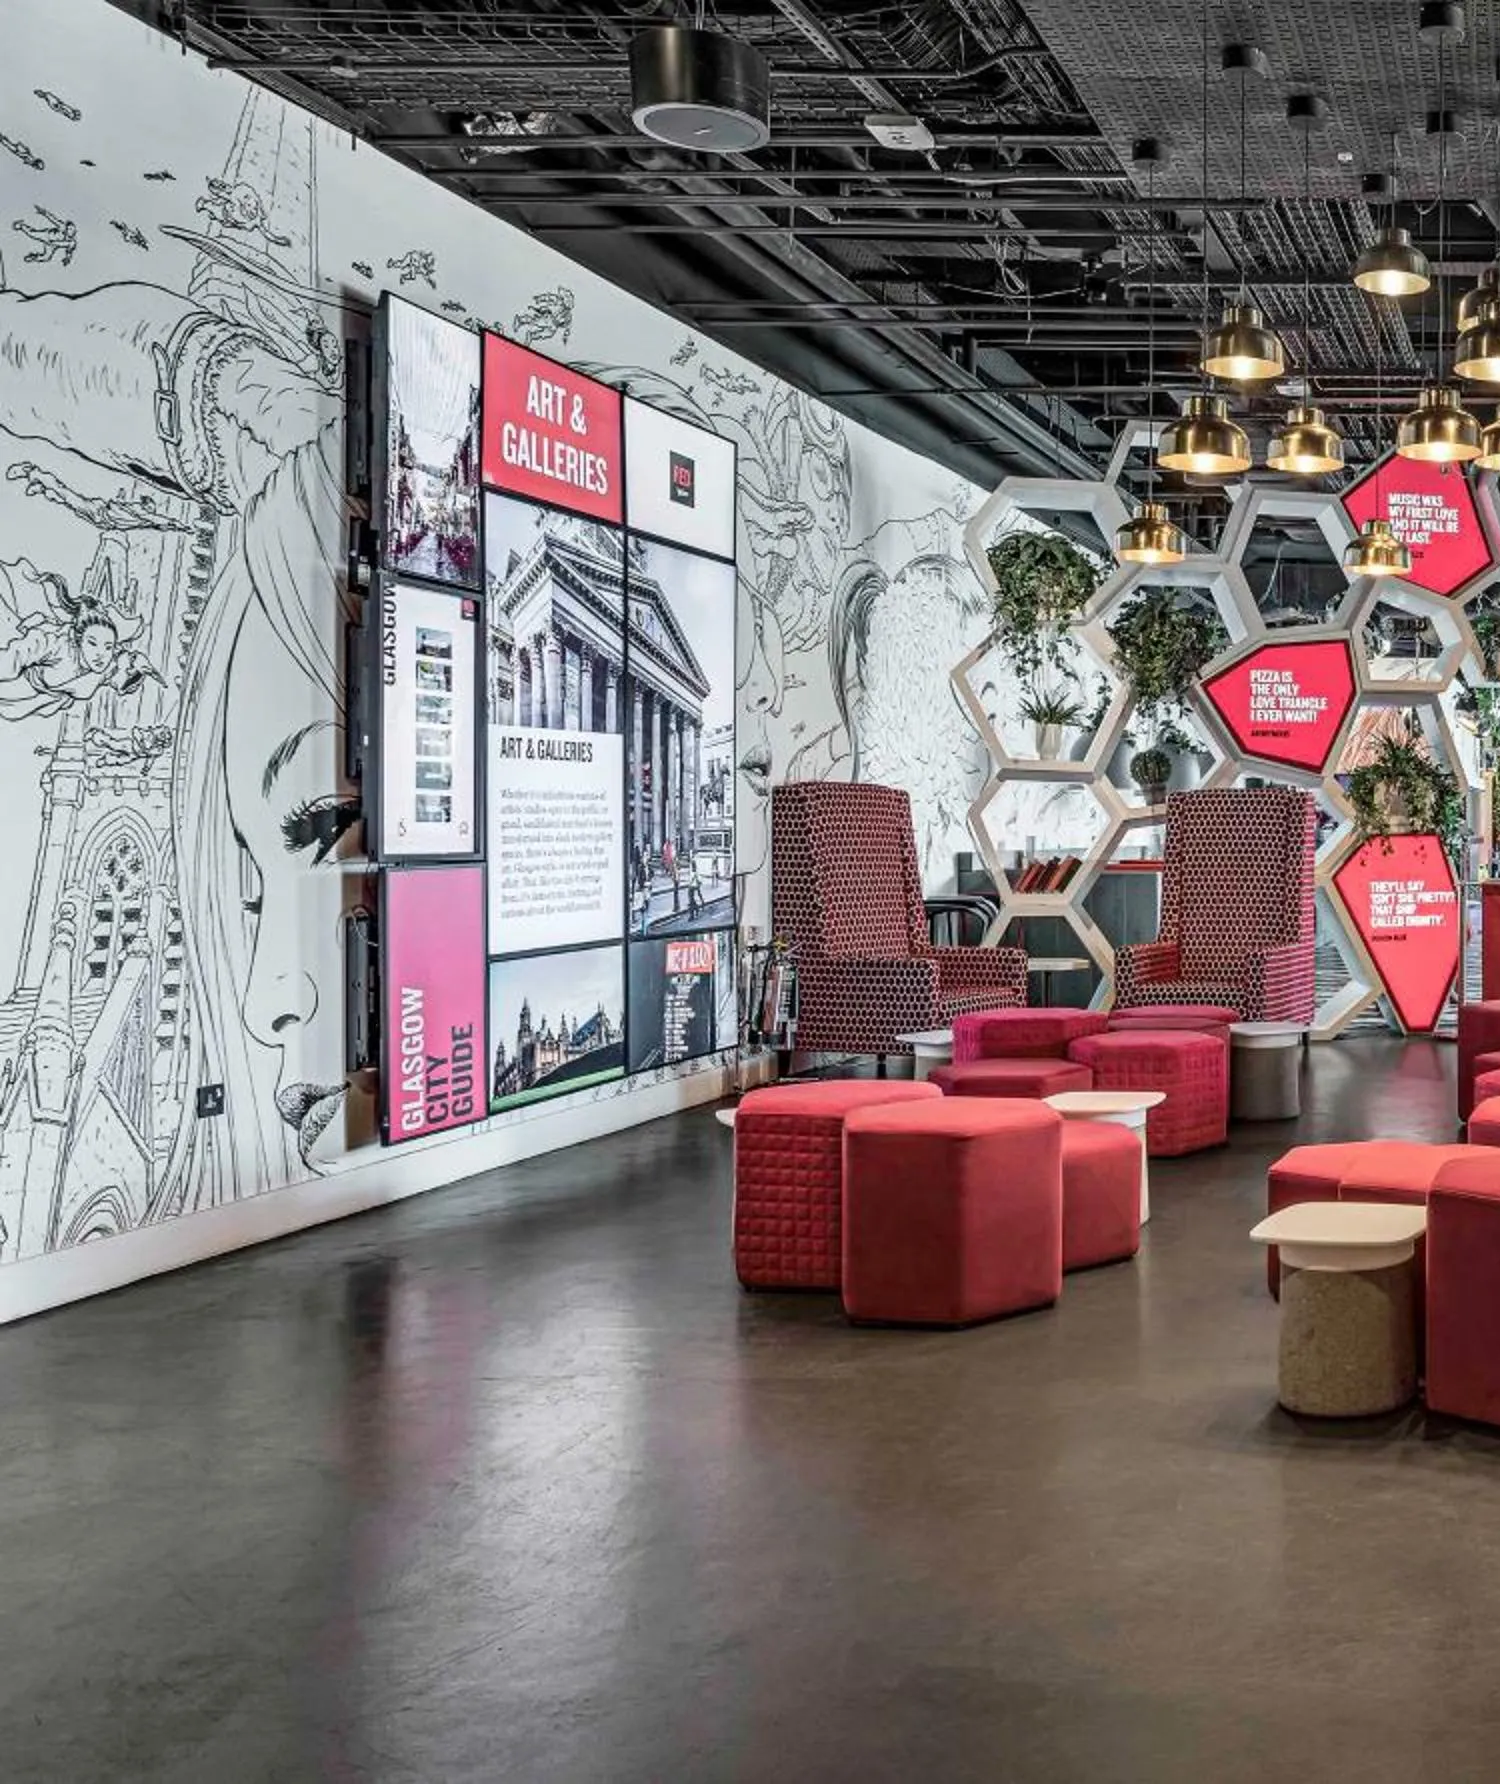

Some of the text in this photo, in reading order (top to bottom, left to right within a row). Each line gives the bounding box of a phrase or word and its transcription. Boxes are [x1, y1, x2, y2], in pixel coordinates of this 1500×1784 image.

[526, 375, 588, 437] ART &
[502, 423, 609, 496] GALLERIES
[1388, 493, 1443, 507] MUSIC WAS
[1388, 505, 1459, 521] MY FIRST LOVE
[1410, 519, 1420, 531] IT
[1422, 520, 1444, 533] WILL
[1446, 521, 1460, 534] BE
[384, 581, 397, 687] GLASGOW
[1250, 669, 1293, 683] PIZZA IS
[1250, 683, 1299, 696] THE ONLY
[1250, 696, 1328, 710] LOVE TRIANGLE
[1257, 710, 1283, 722] EVER
[500, 736, 593, 763] ART & GALLERIES
[1371, 904, 1393, 916] THAT
[401, 987, 424, 1132] GLASGOW
[451, 1022, 474, 1119] GUIDE
[426, 1055, 449, 1125] CITY
